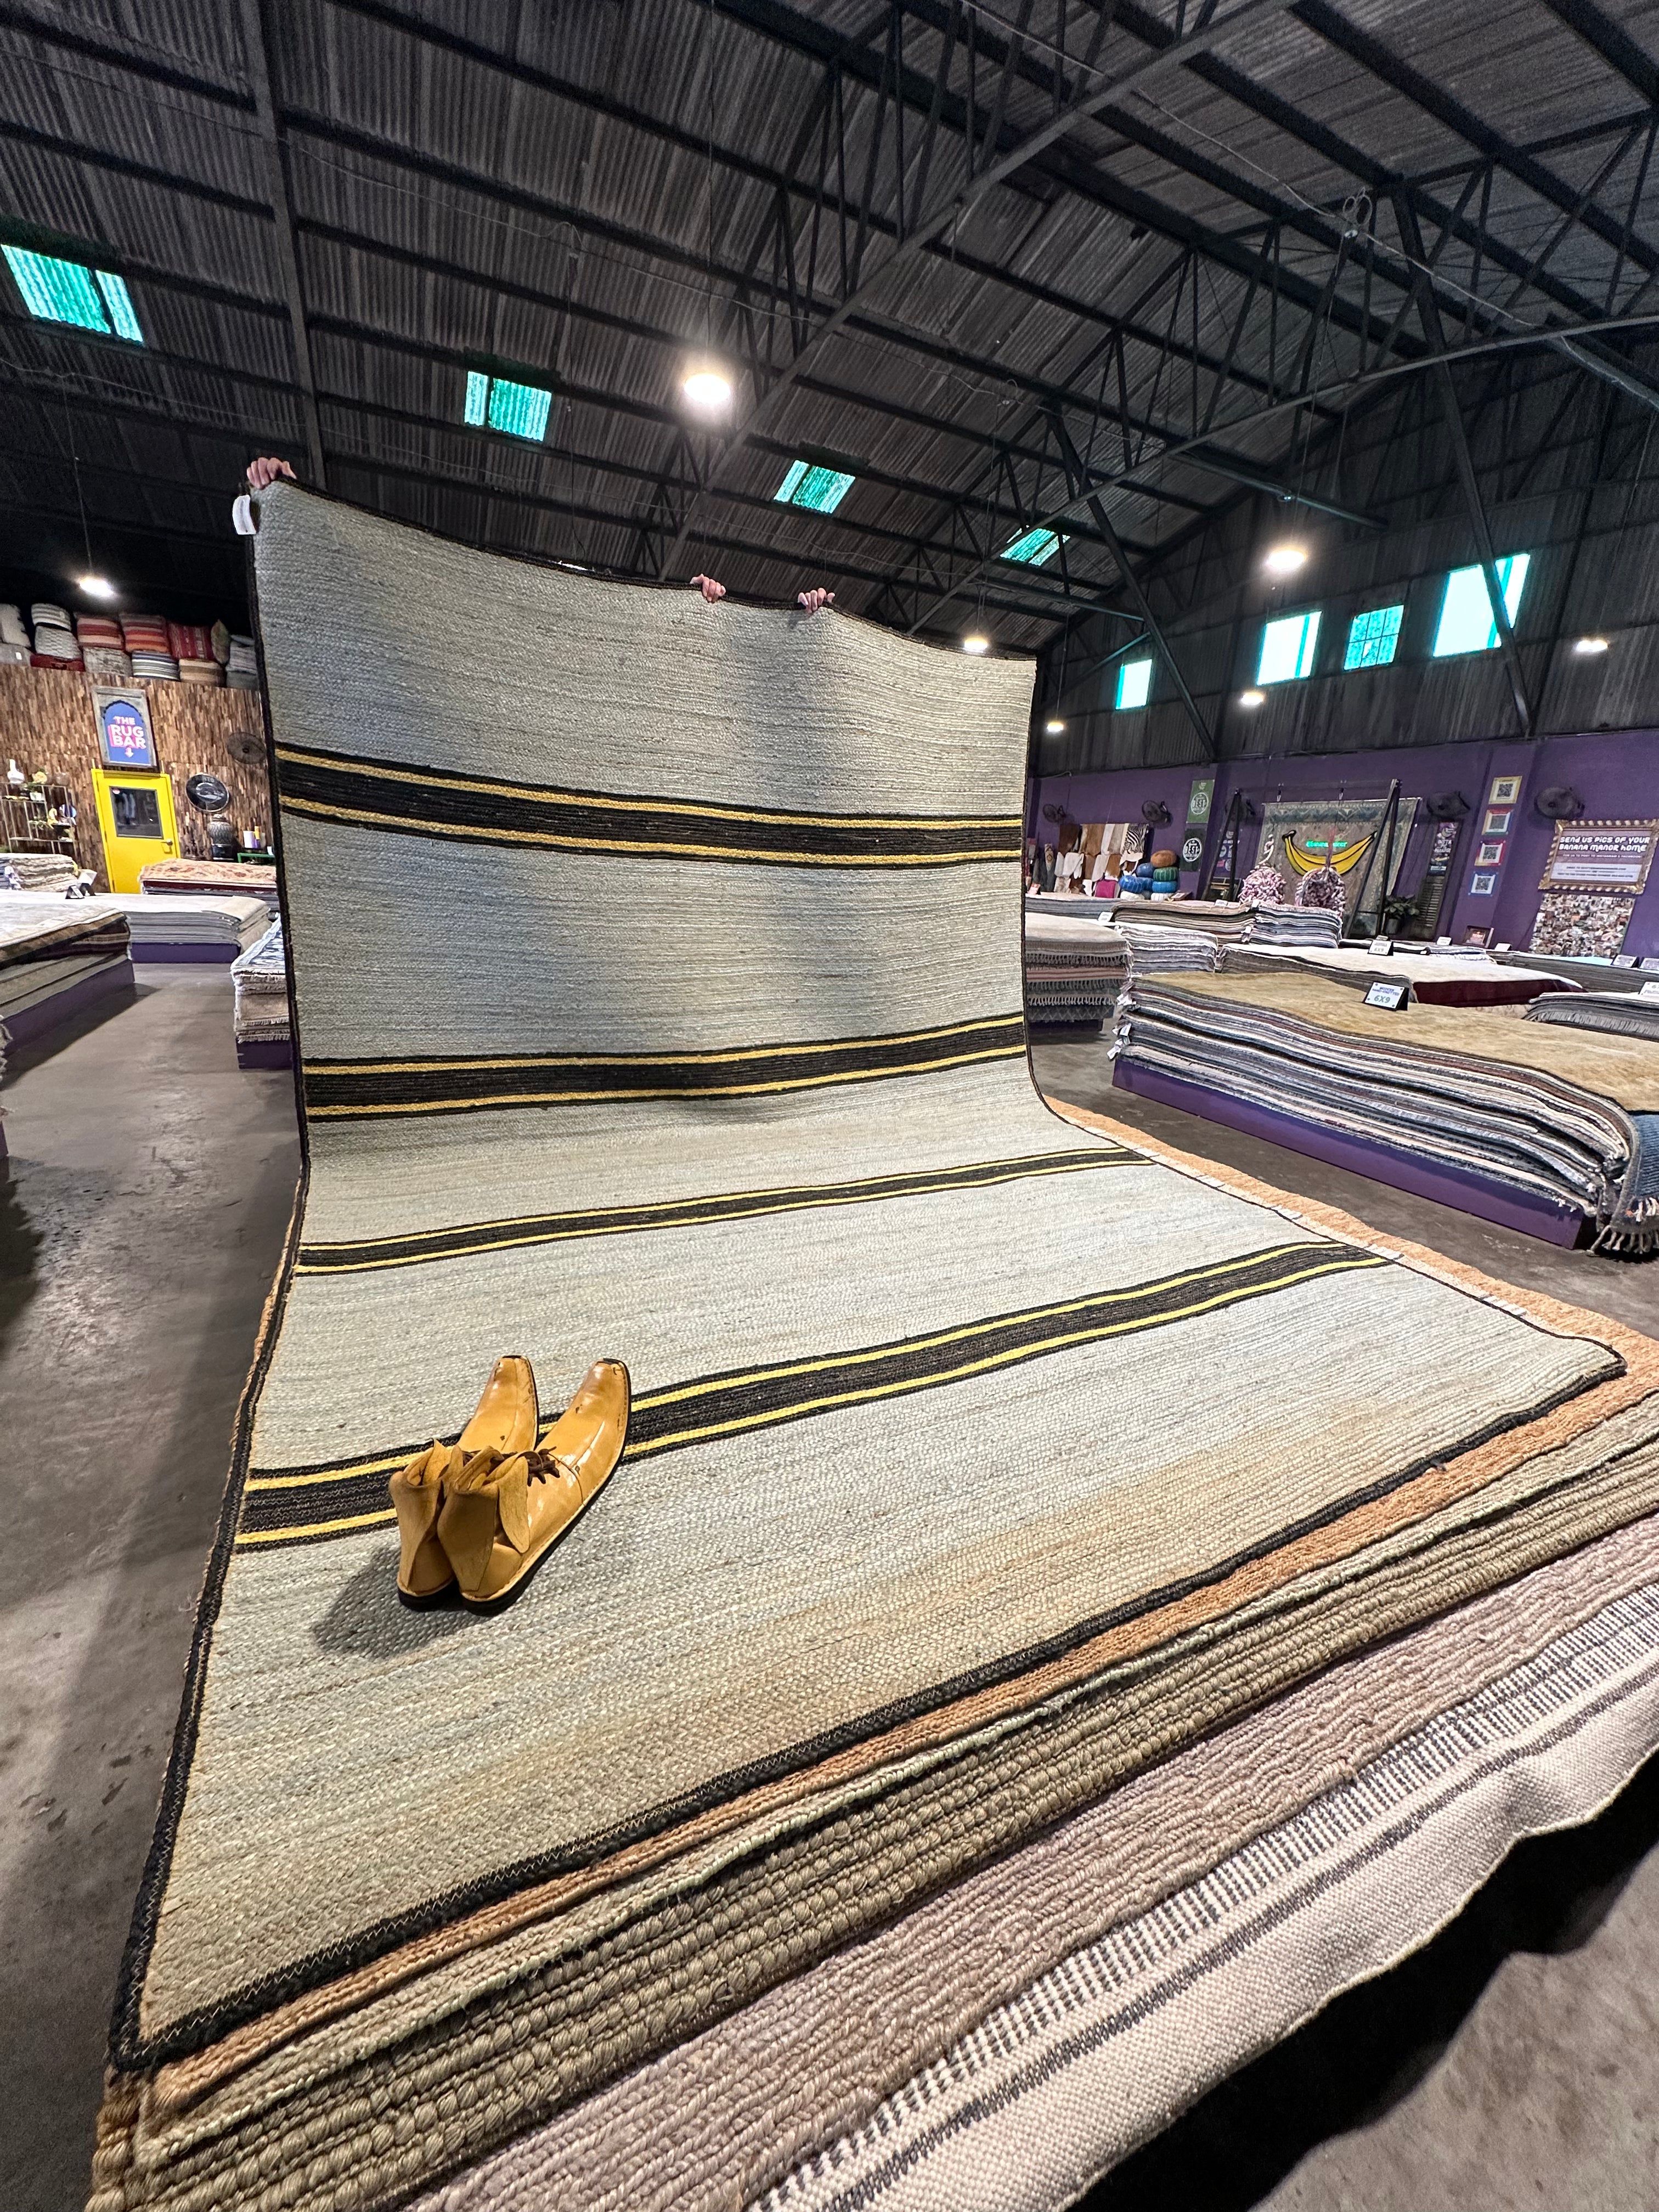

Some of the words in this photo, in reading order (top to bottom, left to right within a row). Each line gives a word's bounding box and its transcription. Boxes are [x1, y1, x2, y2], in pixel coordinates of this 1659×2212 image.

[113, 716, 136, 725] THE
[110, 724, 144, 737] RUG
[112, 736, 146, 749] BAR
[1374, 995, 1391, 1003] 6X9
